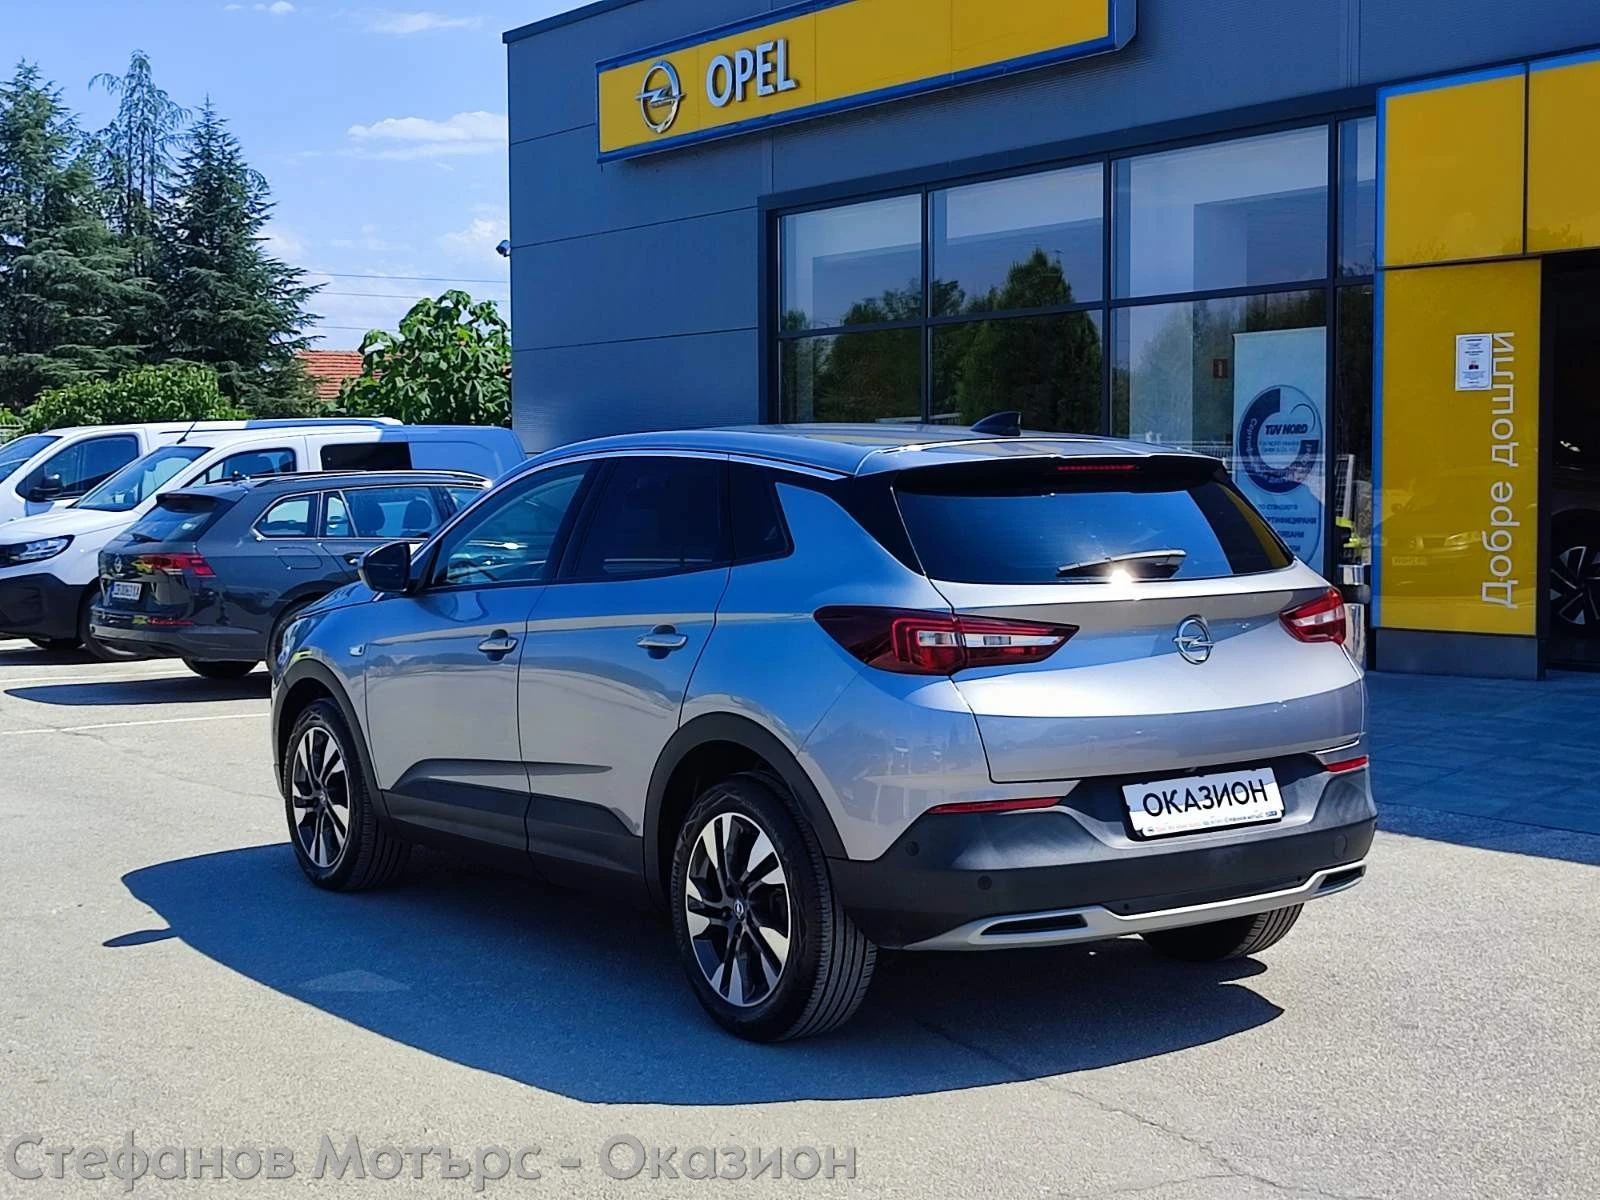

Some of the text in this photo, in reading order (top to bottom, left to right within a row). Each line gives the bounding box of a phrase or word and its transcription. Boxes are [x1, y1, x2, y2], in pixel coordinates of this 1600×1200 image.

[705, 36, 799, 108] OPEL
[1282, 423, 1308, 434] NORD
[1481, 332, 1520, 609] Добре дошли
[1142, 778, 1268, 817] ОКАЗИОН
